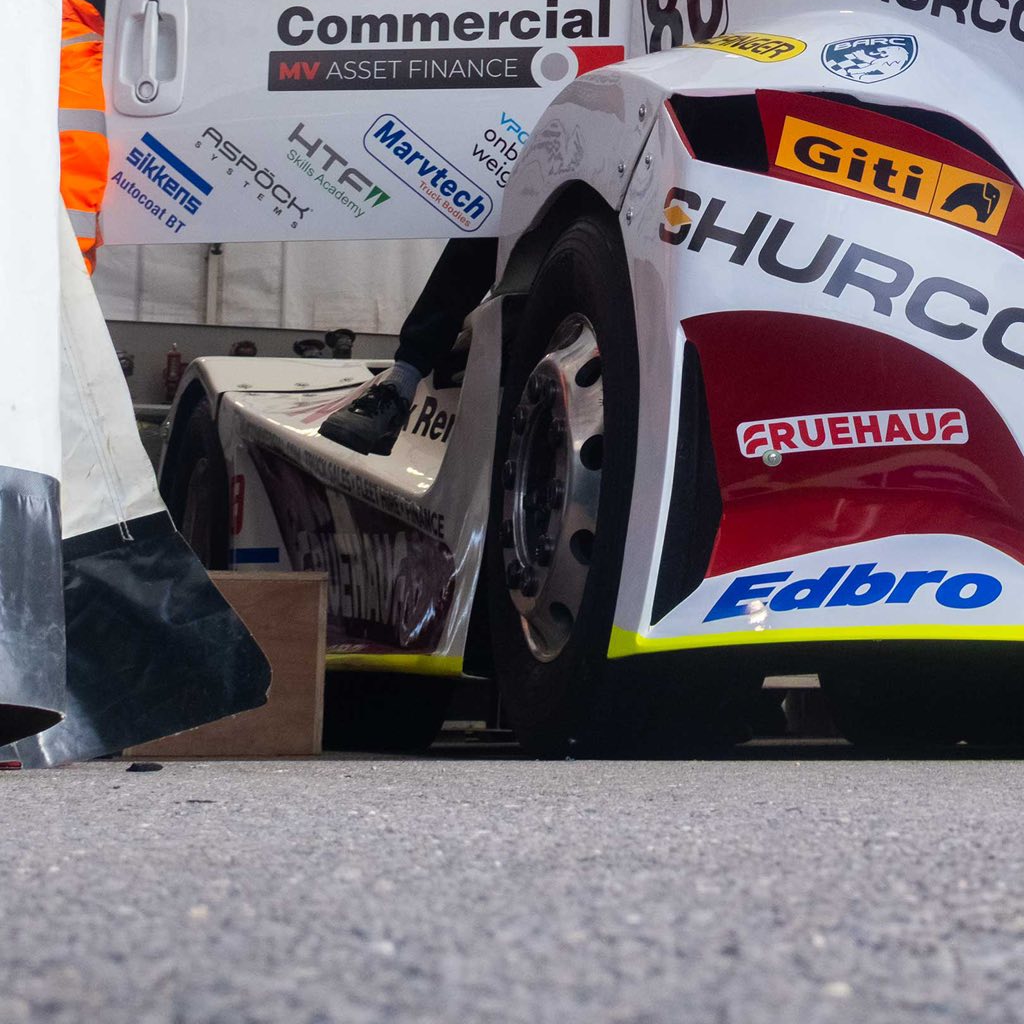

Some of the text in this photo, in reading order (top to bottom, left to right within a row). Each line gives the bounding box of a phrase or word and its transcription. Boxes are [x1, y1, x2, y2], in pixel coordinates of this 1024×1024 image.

[278, 58, 519, 81] MV ASSET FINANCE
[834, 37, 906, 51] BARC
[126, 147, 203, 216] sikkens
[194, 140, 299, 229] SYSTEMS
[201, 126, 310, 220] ASPÖCK
[286, 149, 366, 219] Skills Academy
[373, 120, 485, 220] Marvtech
[793, 135, 926, 201] Giti
[111, 171, 187, 234] Autocoat BT
[418, 180, 472, 228] Truck Bodies
[742, 412, 964, 455] FRUEHAUF
[701, 562, 1003, 624] Edbro
